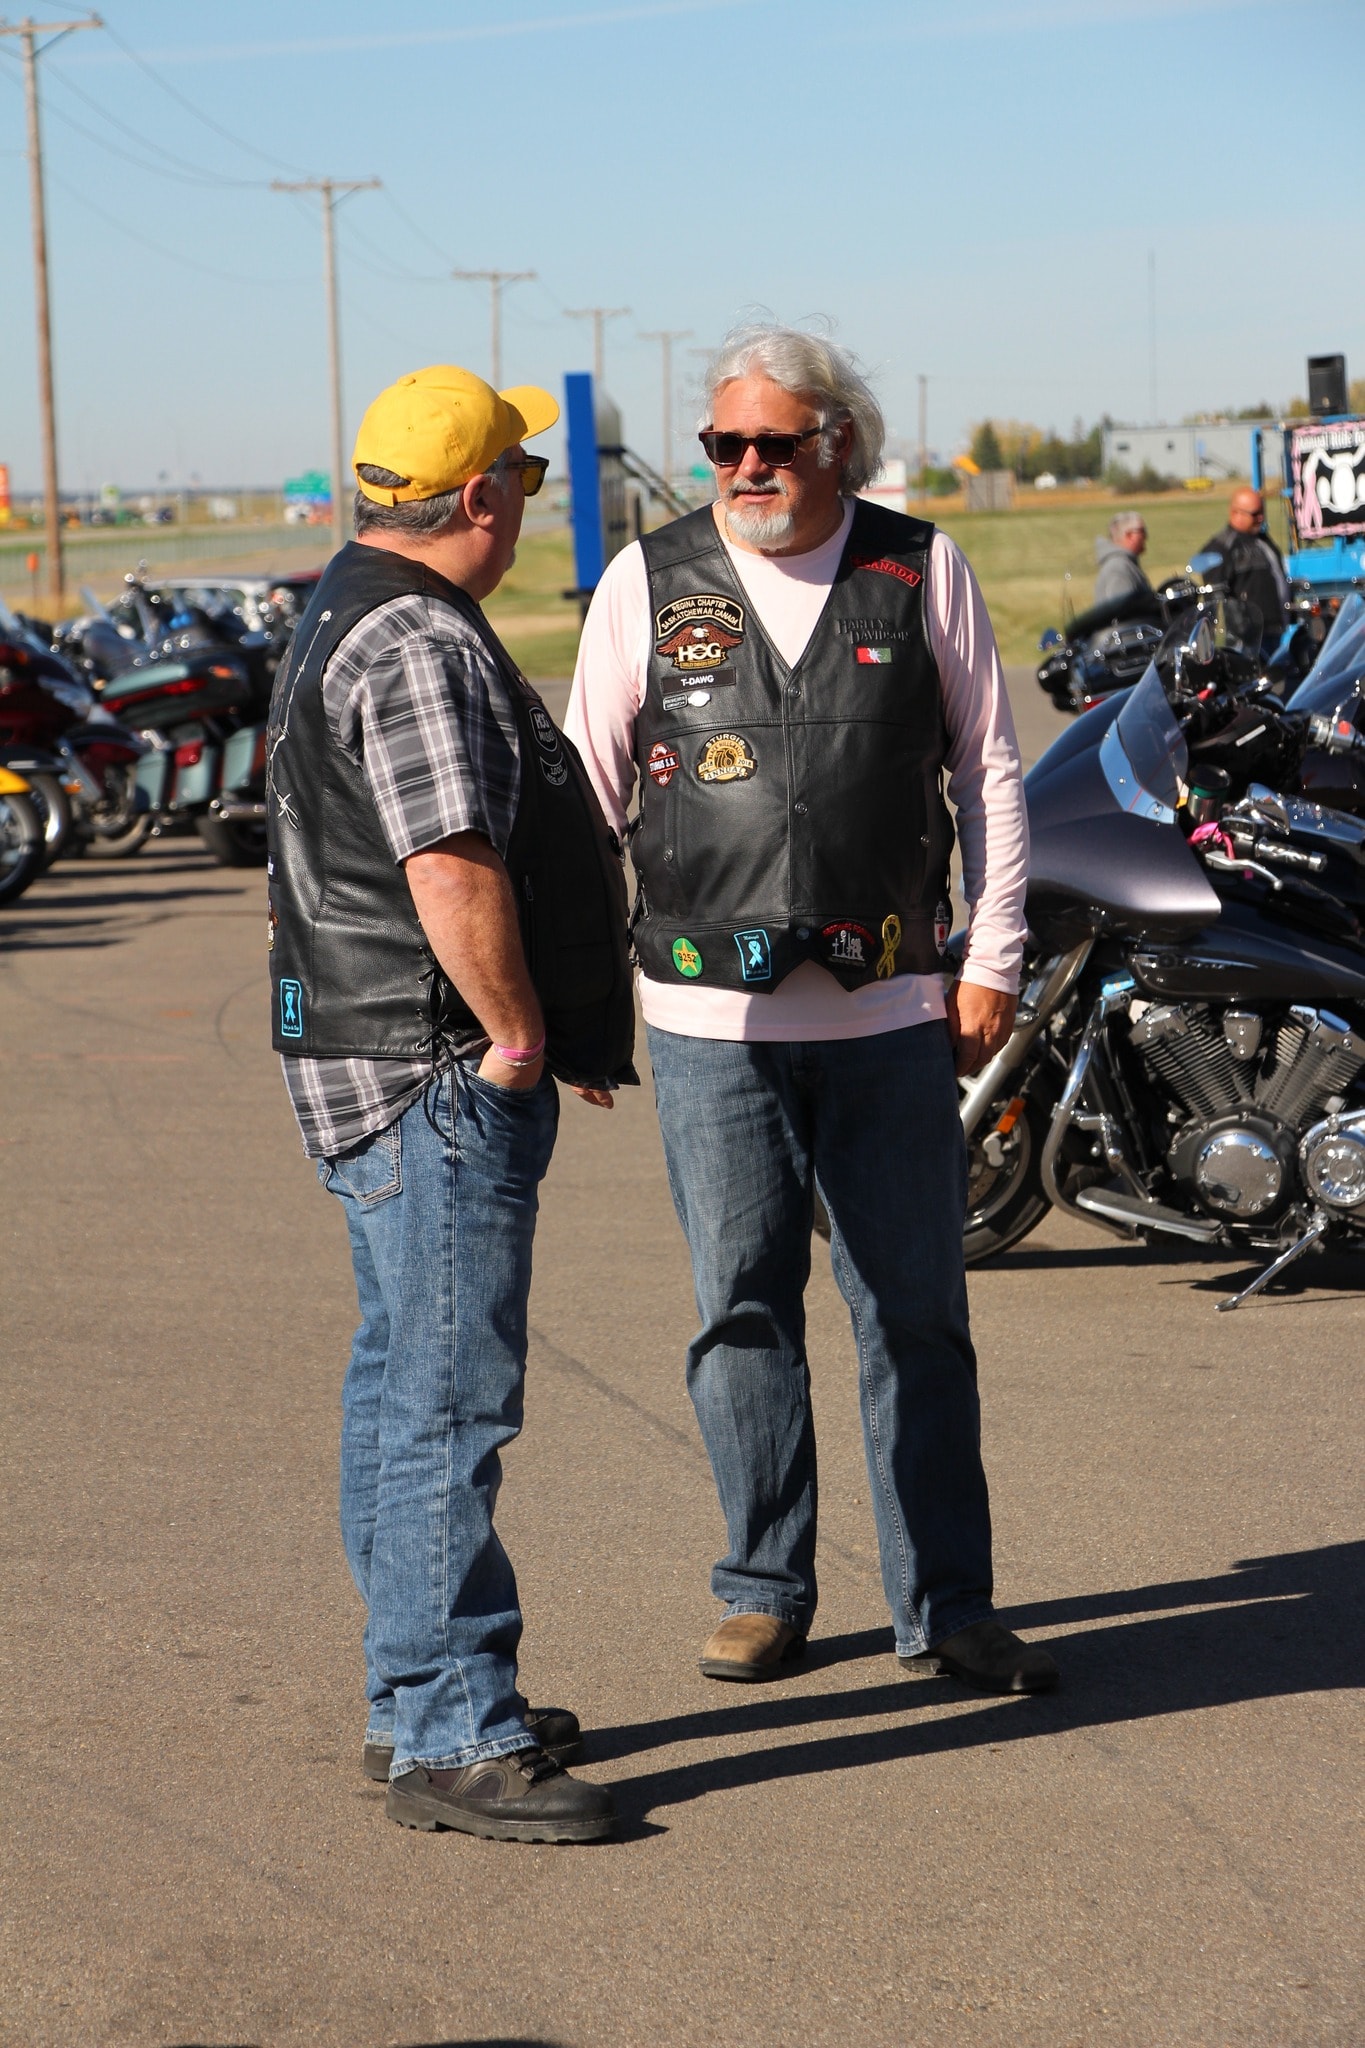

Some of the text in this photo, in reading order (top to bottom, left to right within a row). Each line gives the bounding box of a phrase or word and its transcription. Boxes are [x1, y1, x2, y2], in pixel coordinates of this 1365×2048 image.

[671, 598, 728, 613] REGINA CHAPTER
[661, 607, 739, 630] SASKATCHEWAN CANADA
[677, 642, 722, 662] HOG
[680, 674, 715, 687] T-DAWG
[677, 952, 697, 963] 9252
